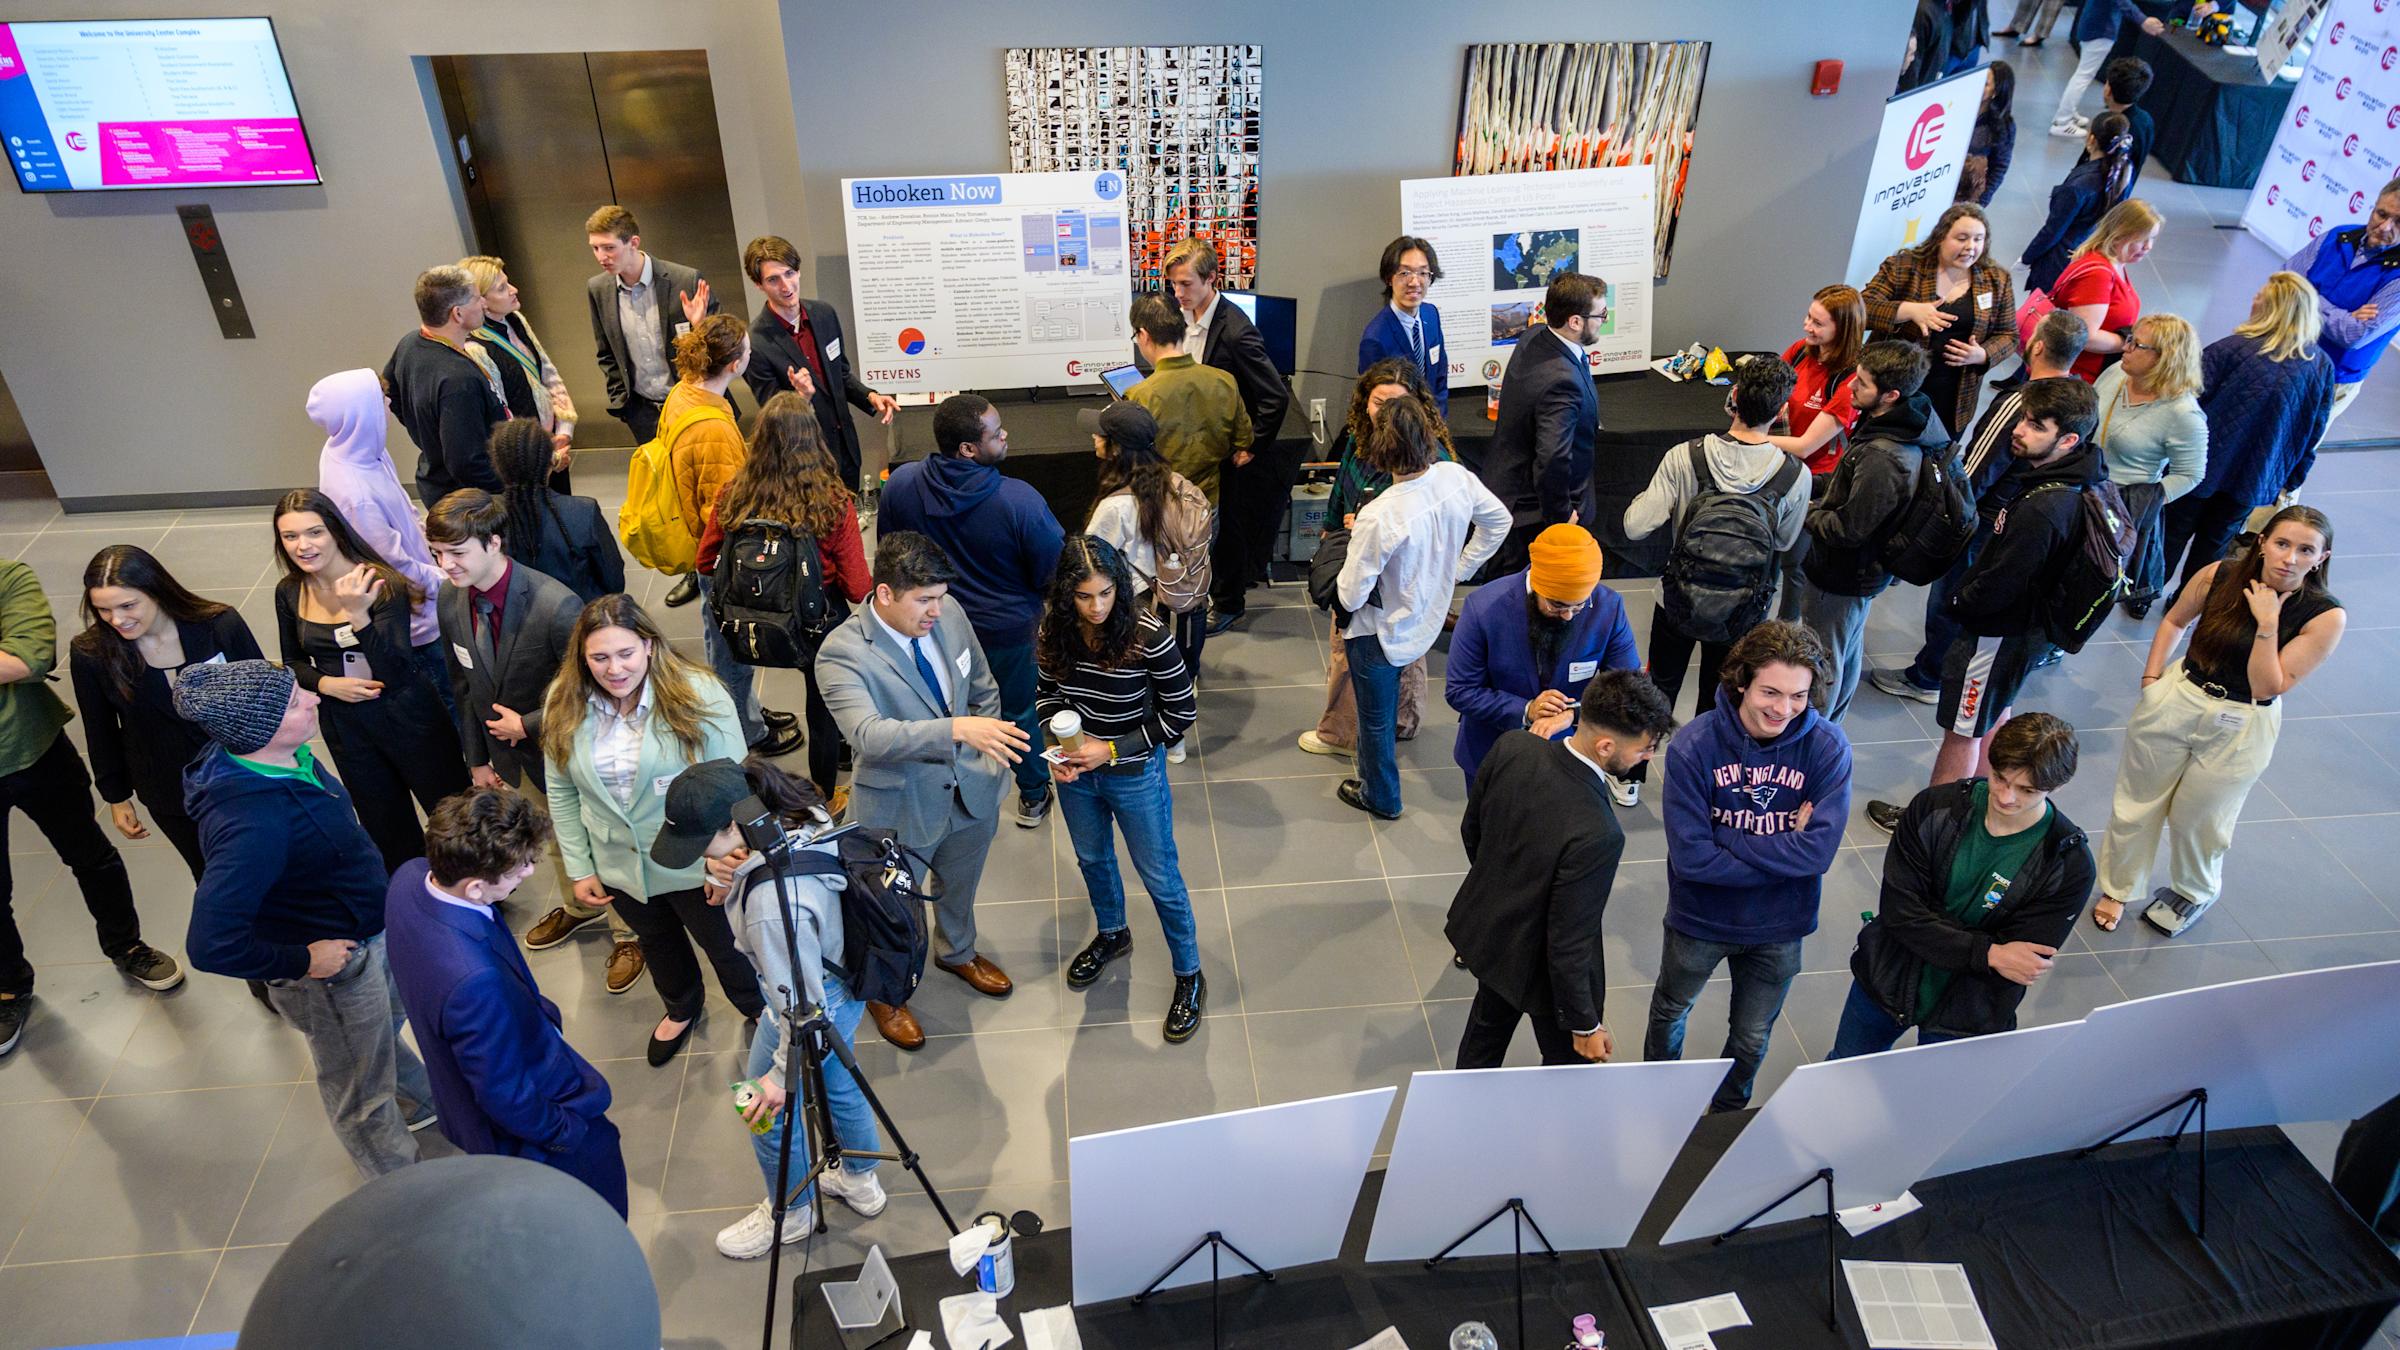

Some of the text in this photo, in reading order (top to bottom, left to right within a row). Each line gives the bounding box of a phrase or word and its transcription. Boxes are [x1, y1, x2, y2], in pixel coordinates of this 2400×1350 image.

[126, 30, 156, 38] University
[1098, 180, 1118, 192] HN
[1874, 162, 1951, 204] innovation
[856, 183, 996, 202] Hoboken Now
[1413, 190, 1448, 200] Applying
[1450, 186, 1484, 195] Machine
[1487, 184, 1520, 194] Learning
[1891, 187, 1926, 212] expo
[1413, 200, 1445, 209] Inspect
[1446, 197, 1487, 207] Hazardous
[1488, 196, 1512, 205] Cargo
[1522, 193, 1533, 202] US
[1535, 193, 1555, 201] Ports
[867, 368, 920, 380] STEVENS
[1713, 763, 1806, 790] NEW ENGLAND
[1711, 807, 1799, 836] PATRIOTS
